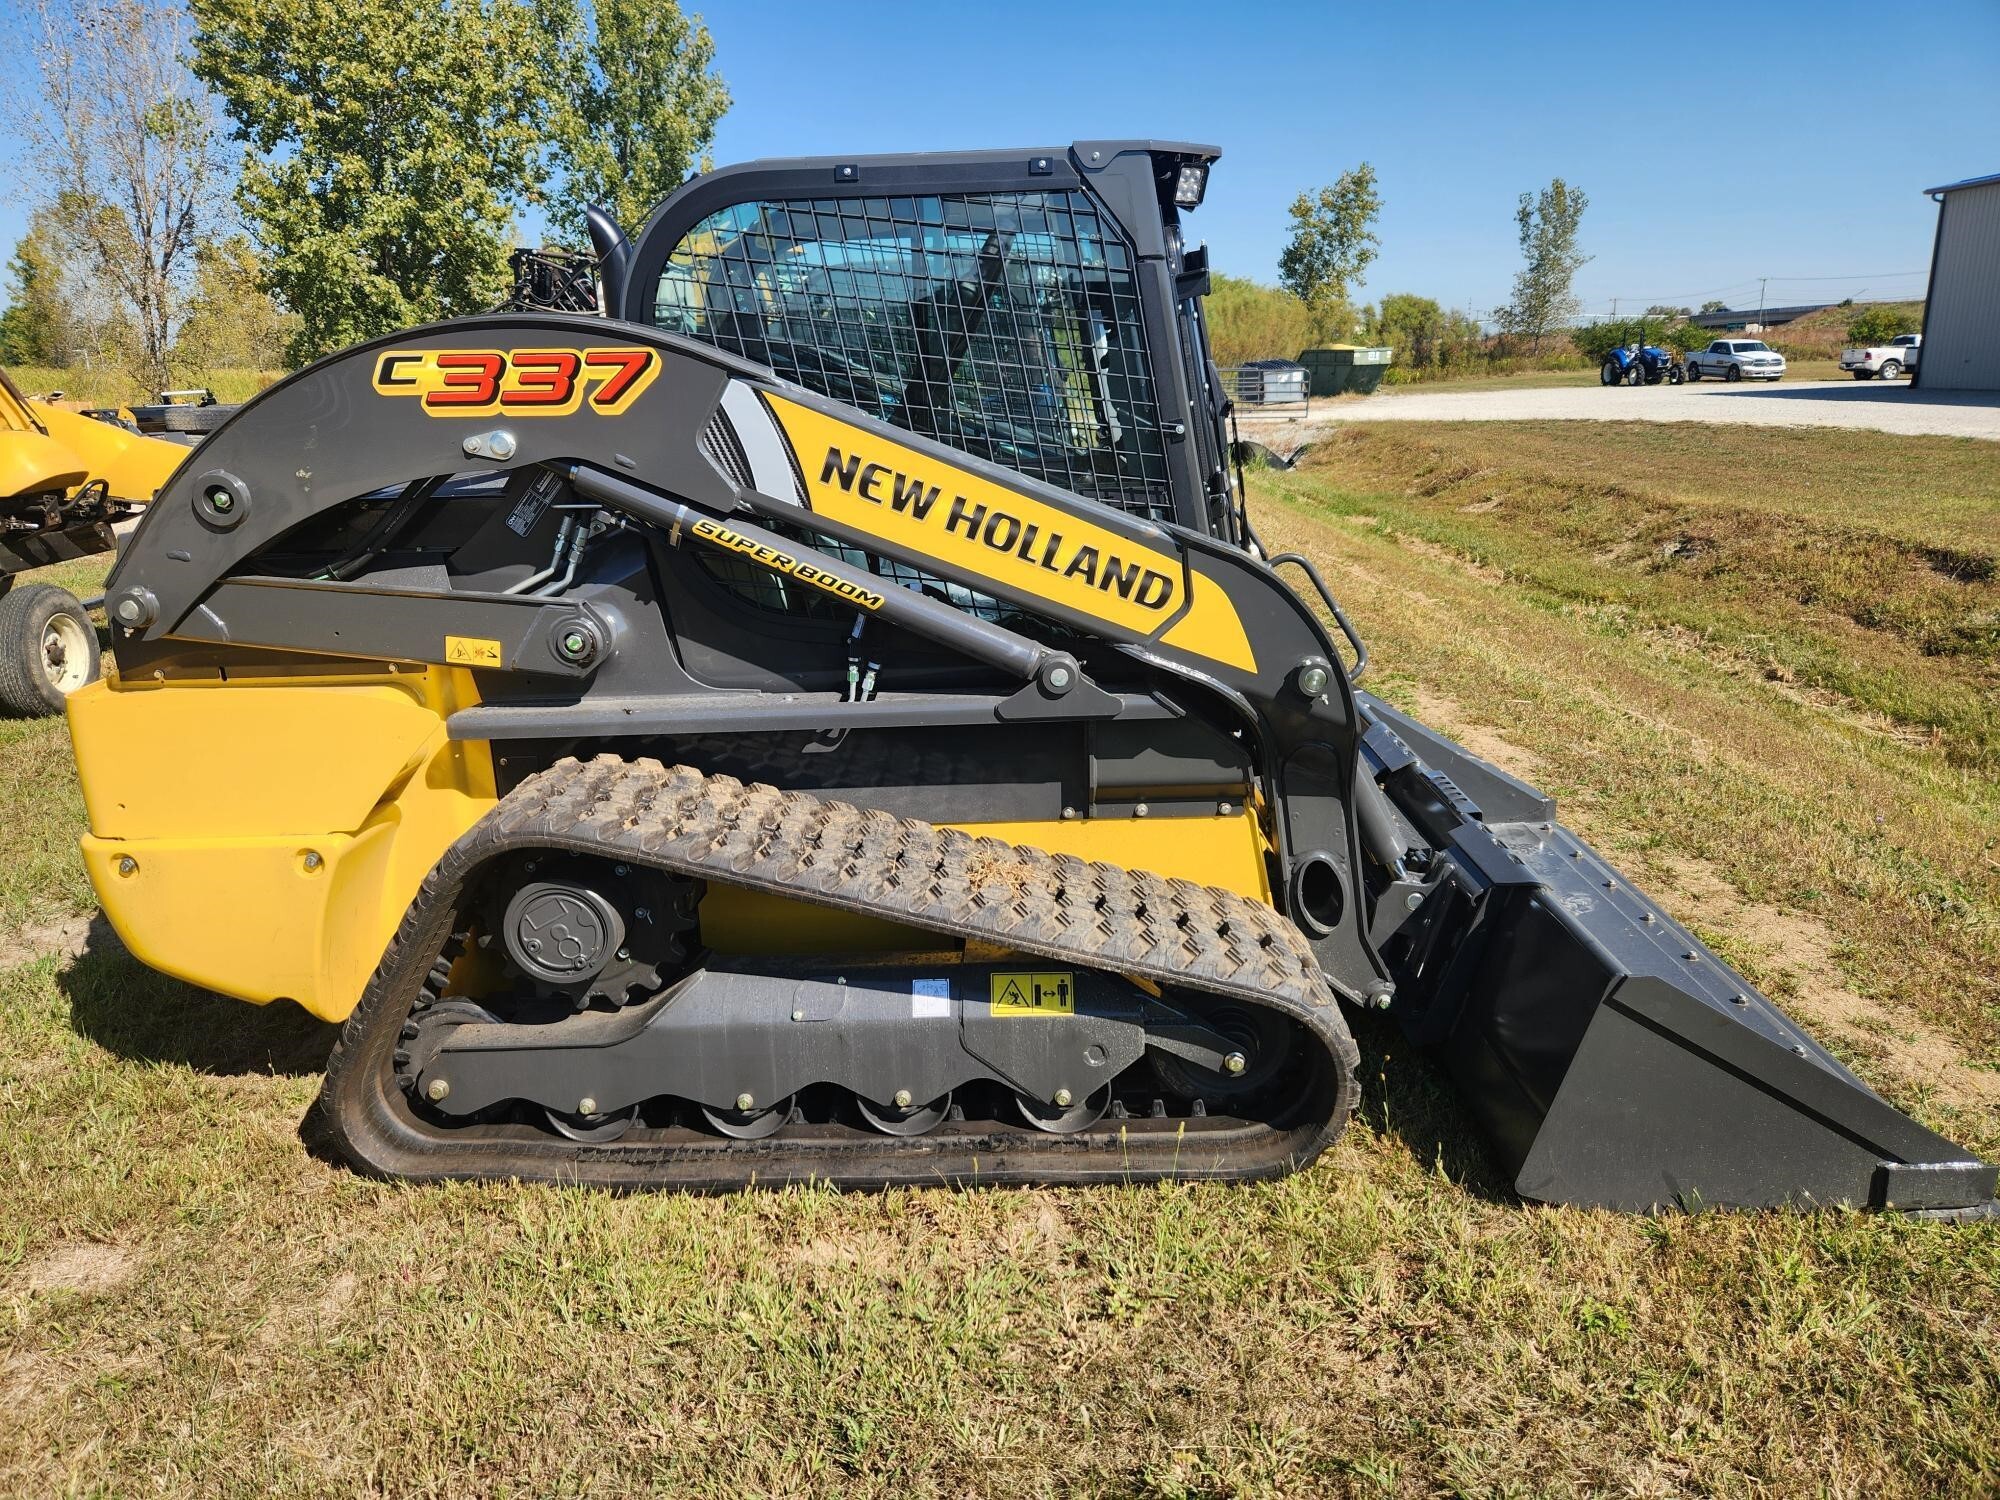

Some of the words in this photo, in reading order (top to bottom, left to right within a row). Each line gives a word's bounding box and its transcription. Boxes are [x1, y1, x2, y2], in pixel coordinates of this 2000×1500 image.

[377, 351, 655, 407] C337
[694, 521, 794, 569] SUPER
[796, 564, 883, 607] BOOM
[819, 446, 942, 521] NEW
[945, 495, 1175, 611] HOLLAND
